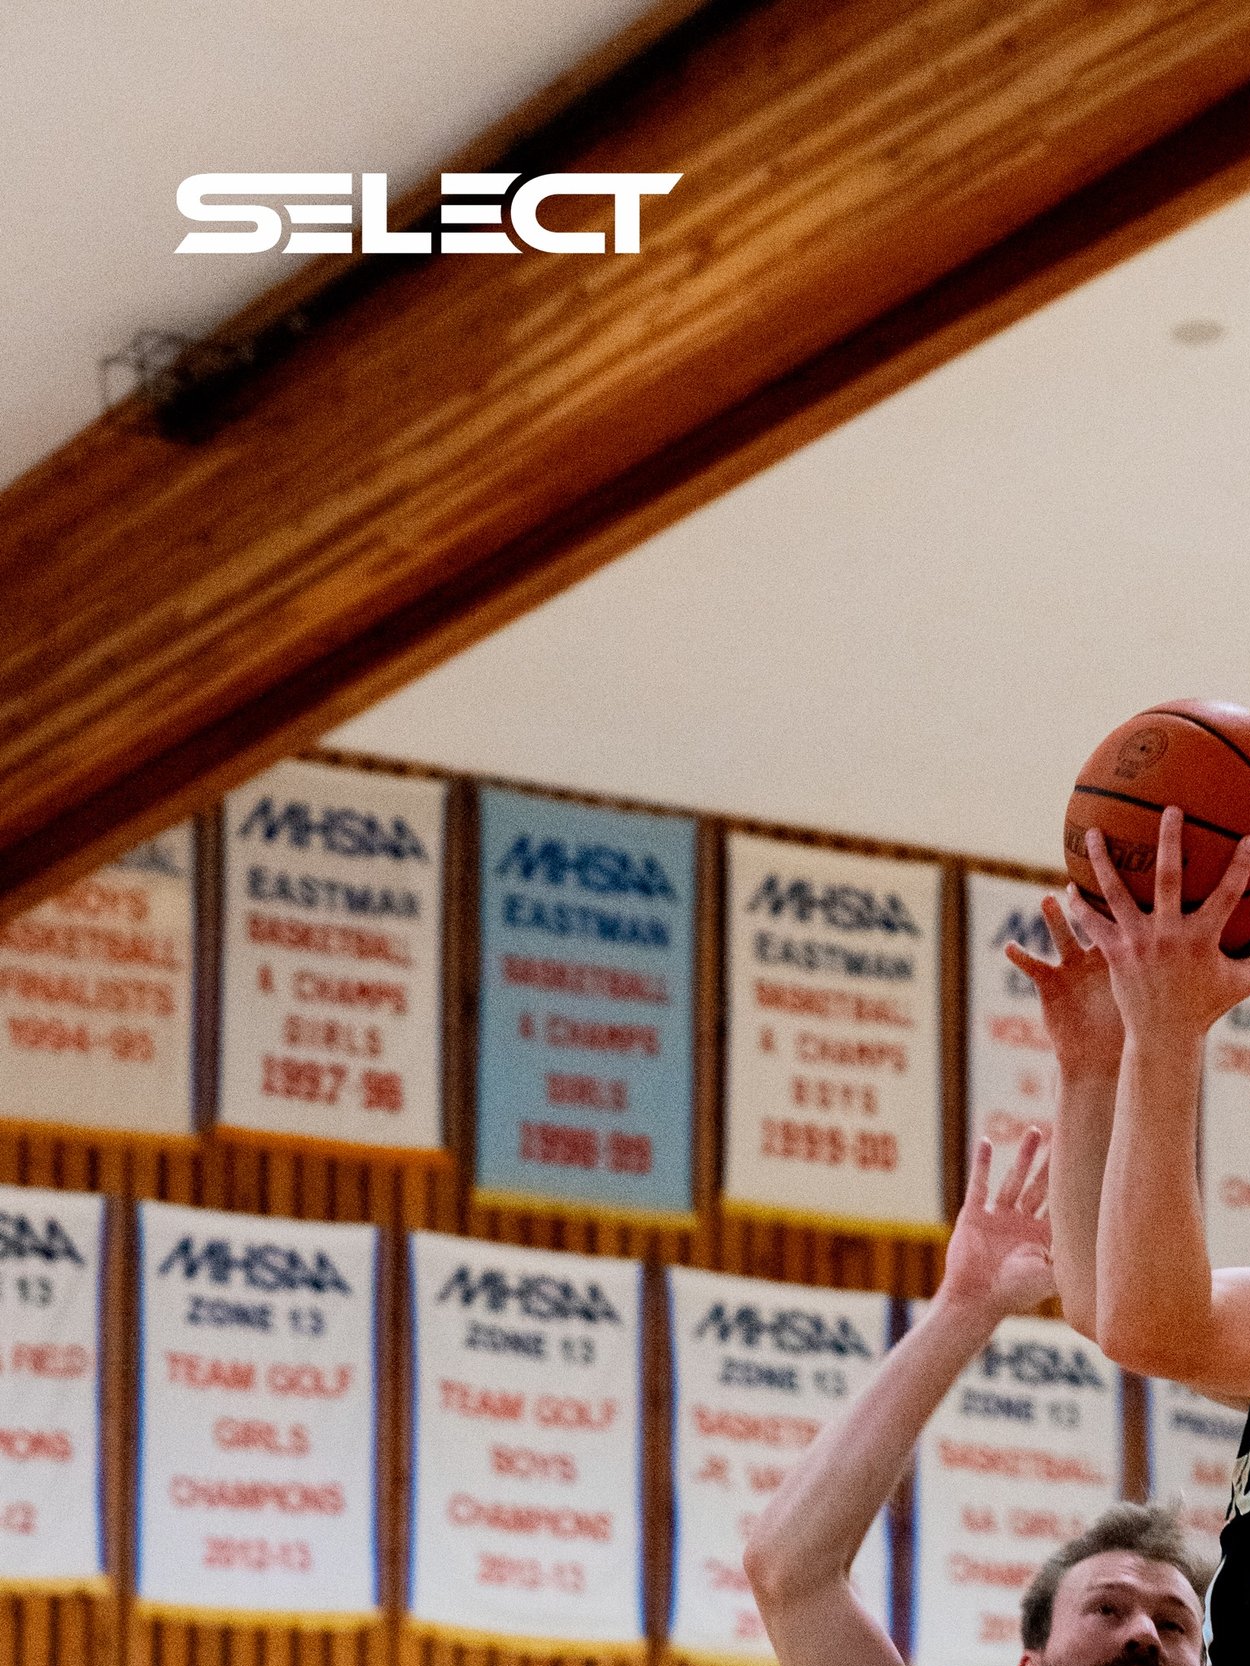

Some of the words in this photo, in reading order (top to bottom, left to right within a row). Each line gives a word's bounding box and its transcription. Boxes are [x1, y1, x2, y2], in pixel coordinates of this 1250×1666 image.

[238, 796, 428, 863] MHSAA
[247, 866, 420, 918] EASTMAN
[496, 833, 680, 904] MHSAA
[504, 895, 670, 948] EASTMAN
[746, 874, 922, 937] MHSAA
[246, 911, 412, 968] BASKETBALL
[755, 933, 914, 981] EASTMAN
[294, 972, 406, 1013] CHAMPS
[504, 955, 670, 1004] BASKETBALL
[755, 979, 914, 1028] BASKETBALL
[284, 1016, 382, 1058] GIRLS
[546, 1014, 660, 1056] CHAMPS
[797, 1032, 908, 1075] CHAMPS
[546, 1073, 628, 1112] GIRLS
[792, 1077, 877, 1118] BOYS
[160, 1236, 352, 1296] MHSAA
[187, 1297, 272, 1332] ZONE
[291, 1309, 326, 1337] 13
[437, 1266, 624, 1331] MHSAA
[465, 1321, 547, 1359] ZONE
[561, 1336, 595, 1365] 13
[696, 1302, 872, 1360] MHSAA
[166, 1352, 256, 1393] TEAM
[269, 1364, 352, 1399] GOLF
[719, 1357, 798, 1394] ZONE
[814, 1371, 847, 1399] 13
[982, 1341, 1106, 1392] HSAA
[439, 1379, 525, 1423] TEAM
[536, 1391, 618, 1431] GOLF
[961, 1390, 1033, 1423] ZONE
[214, 1420, 311, 1457] GIRLS
[490, 1444, 577, 1484] BOYS
[938, 1439, 1106, 1486] BASKETBALL
[171, 1477, 345, 1517] CHAMPIONS
[447, 1495, 612, 1542] CHAMPIONS
